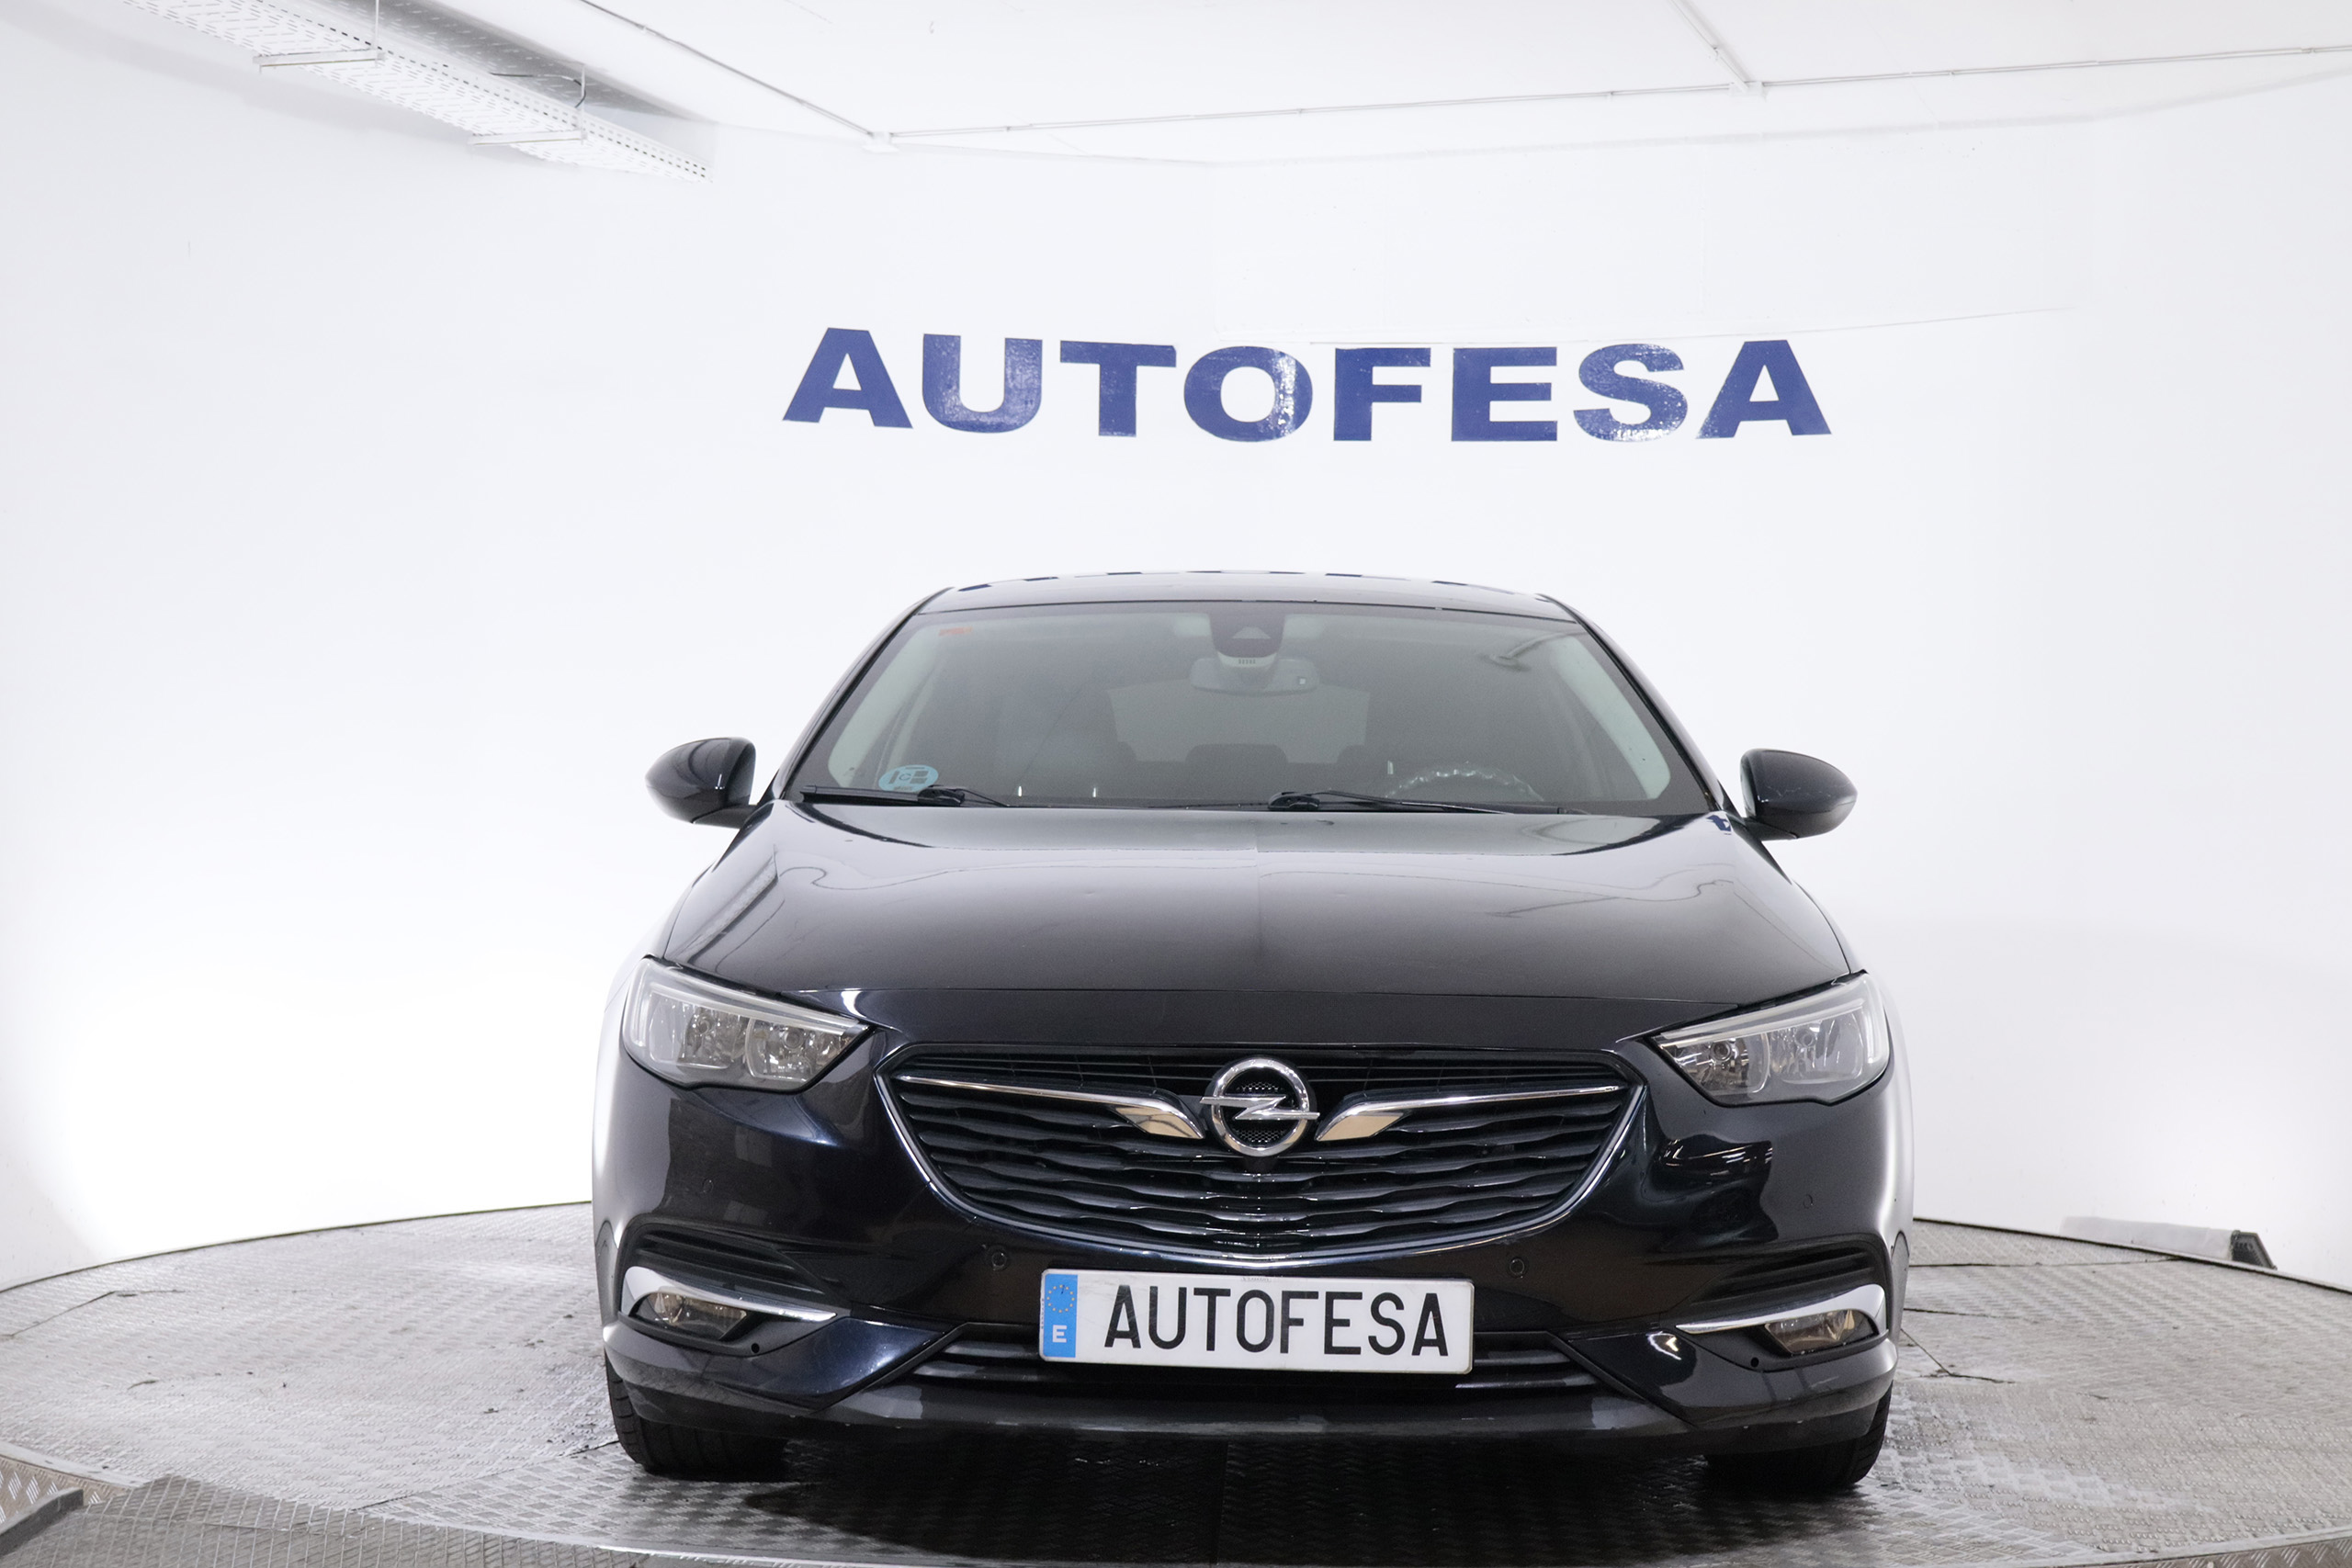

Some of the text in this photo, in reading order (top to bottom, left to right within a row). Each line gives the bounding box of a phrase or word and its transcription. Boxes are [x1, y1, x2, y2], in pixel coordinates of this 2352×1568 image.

[783, 328, 1831, 442] AUTOFESA
[1052, 1324, 1068, 1343] E
[1105, 1285, 1448, 1356] AUTOFESA
